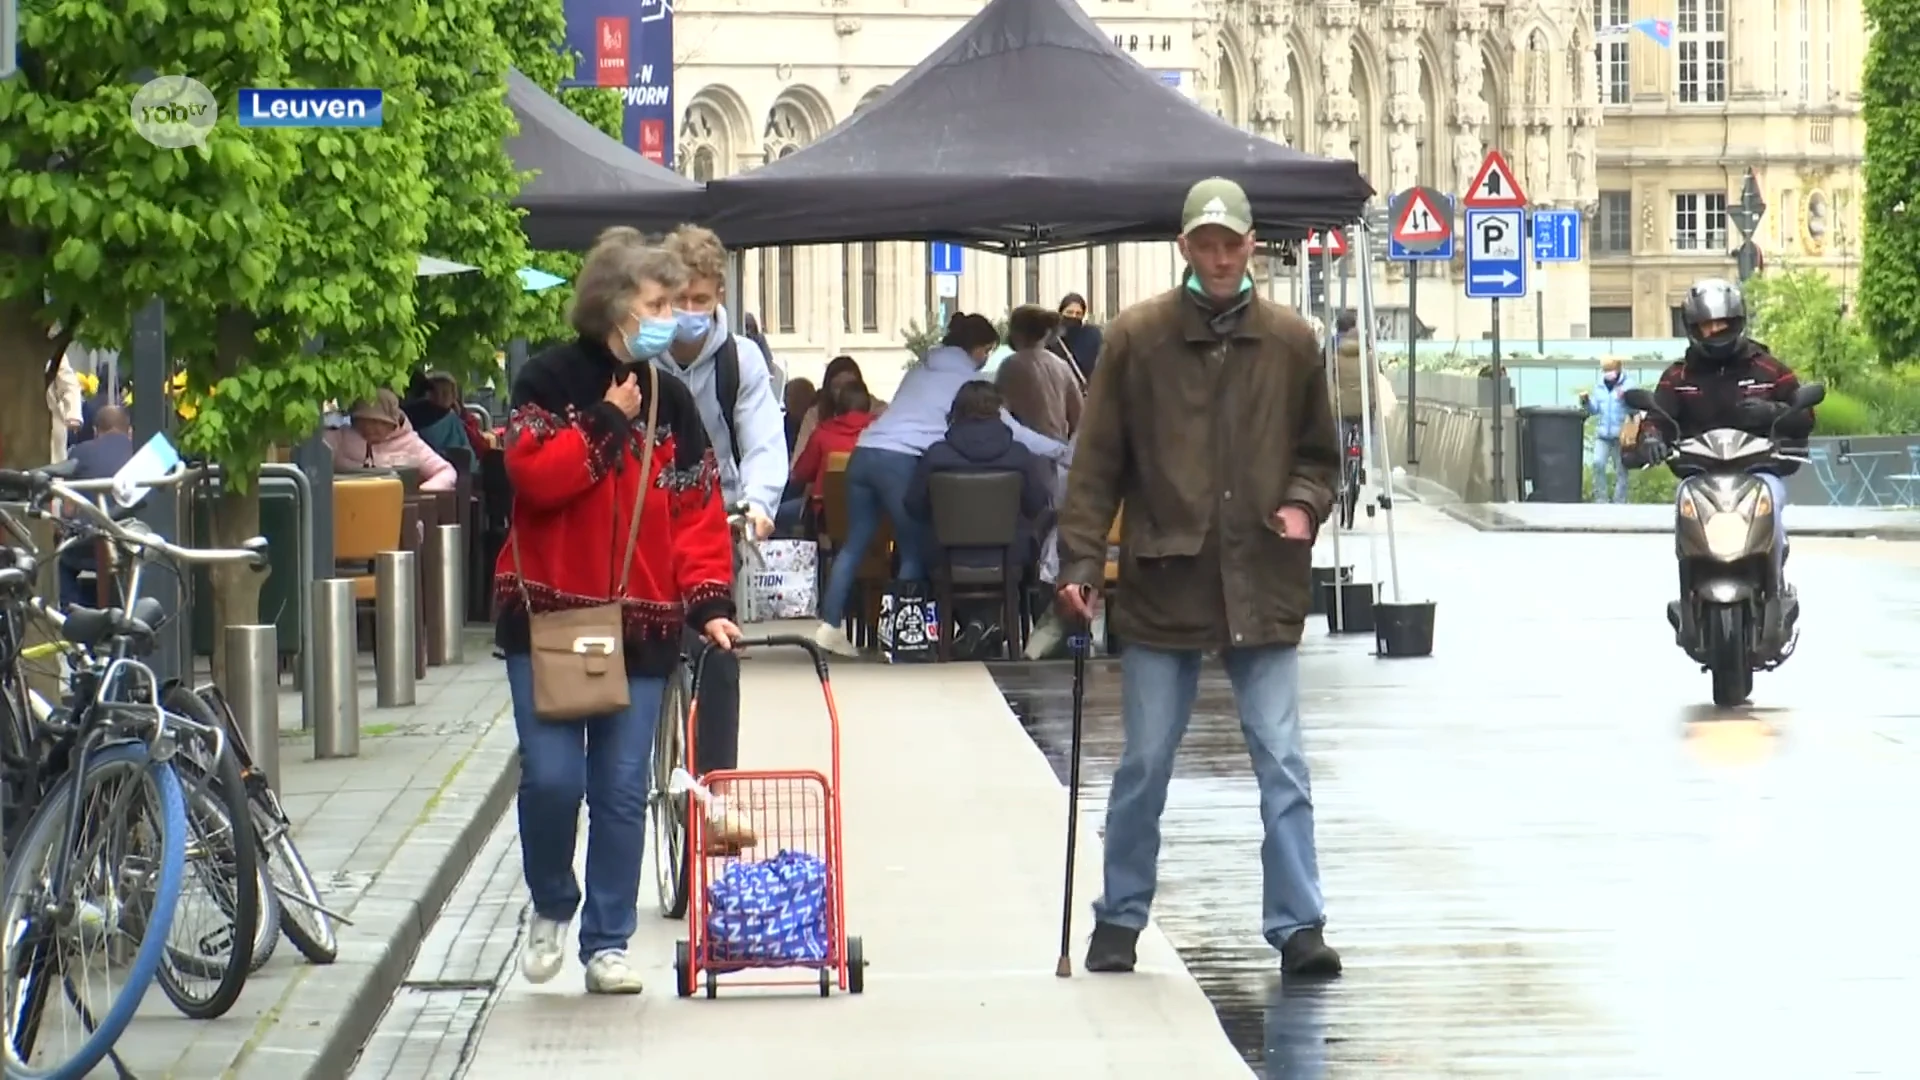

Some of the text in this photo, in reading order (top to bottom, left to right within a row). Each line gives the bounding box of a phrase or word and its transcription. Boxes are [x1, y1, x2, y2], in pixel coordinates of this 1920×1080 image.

[599, 58, 625, 68] LEUVEN
[612, 86, 669, 106] PVORM
[1483, 225, 1504, 254] P
